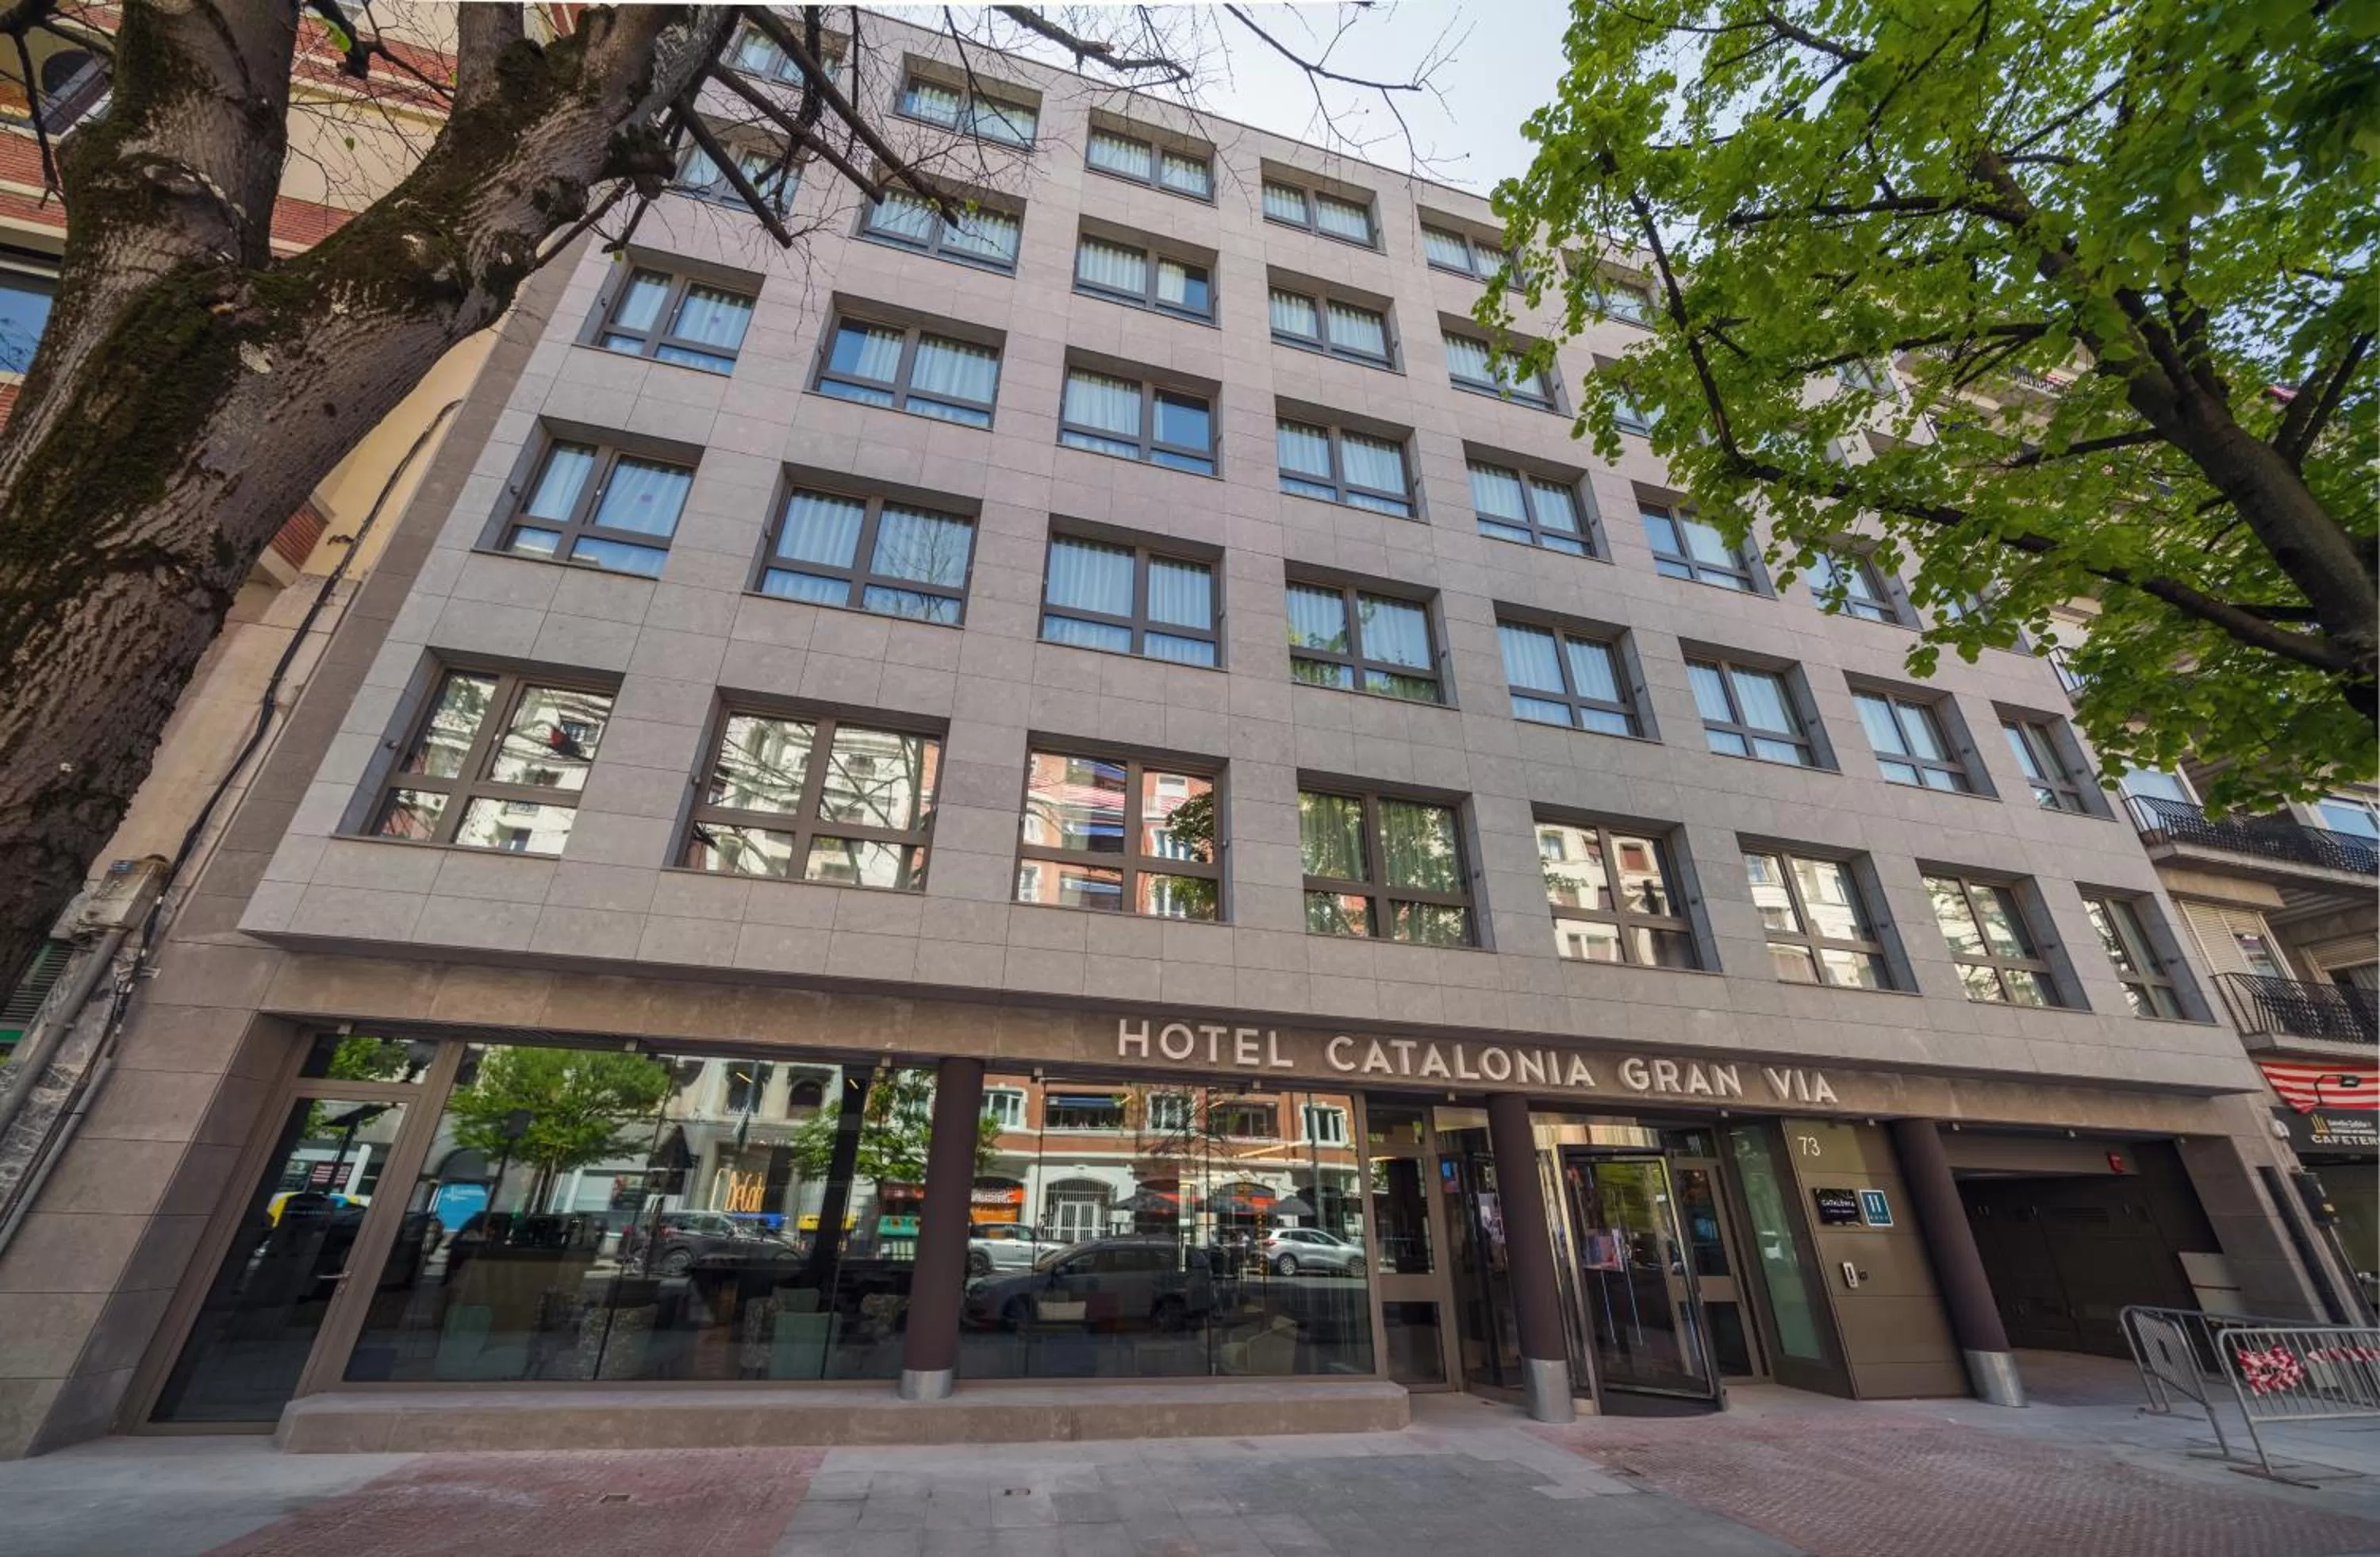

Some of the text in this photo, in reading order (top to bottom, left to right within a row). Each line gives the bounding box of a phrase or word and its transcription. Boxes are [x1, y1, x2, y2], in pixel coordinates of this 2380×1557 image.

[1117, 1018, 1839, 1104] HOTEL CATALONIA GRAN VIA
[1797, 1136, 1821, 1157] 73
